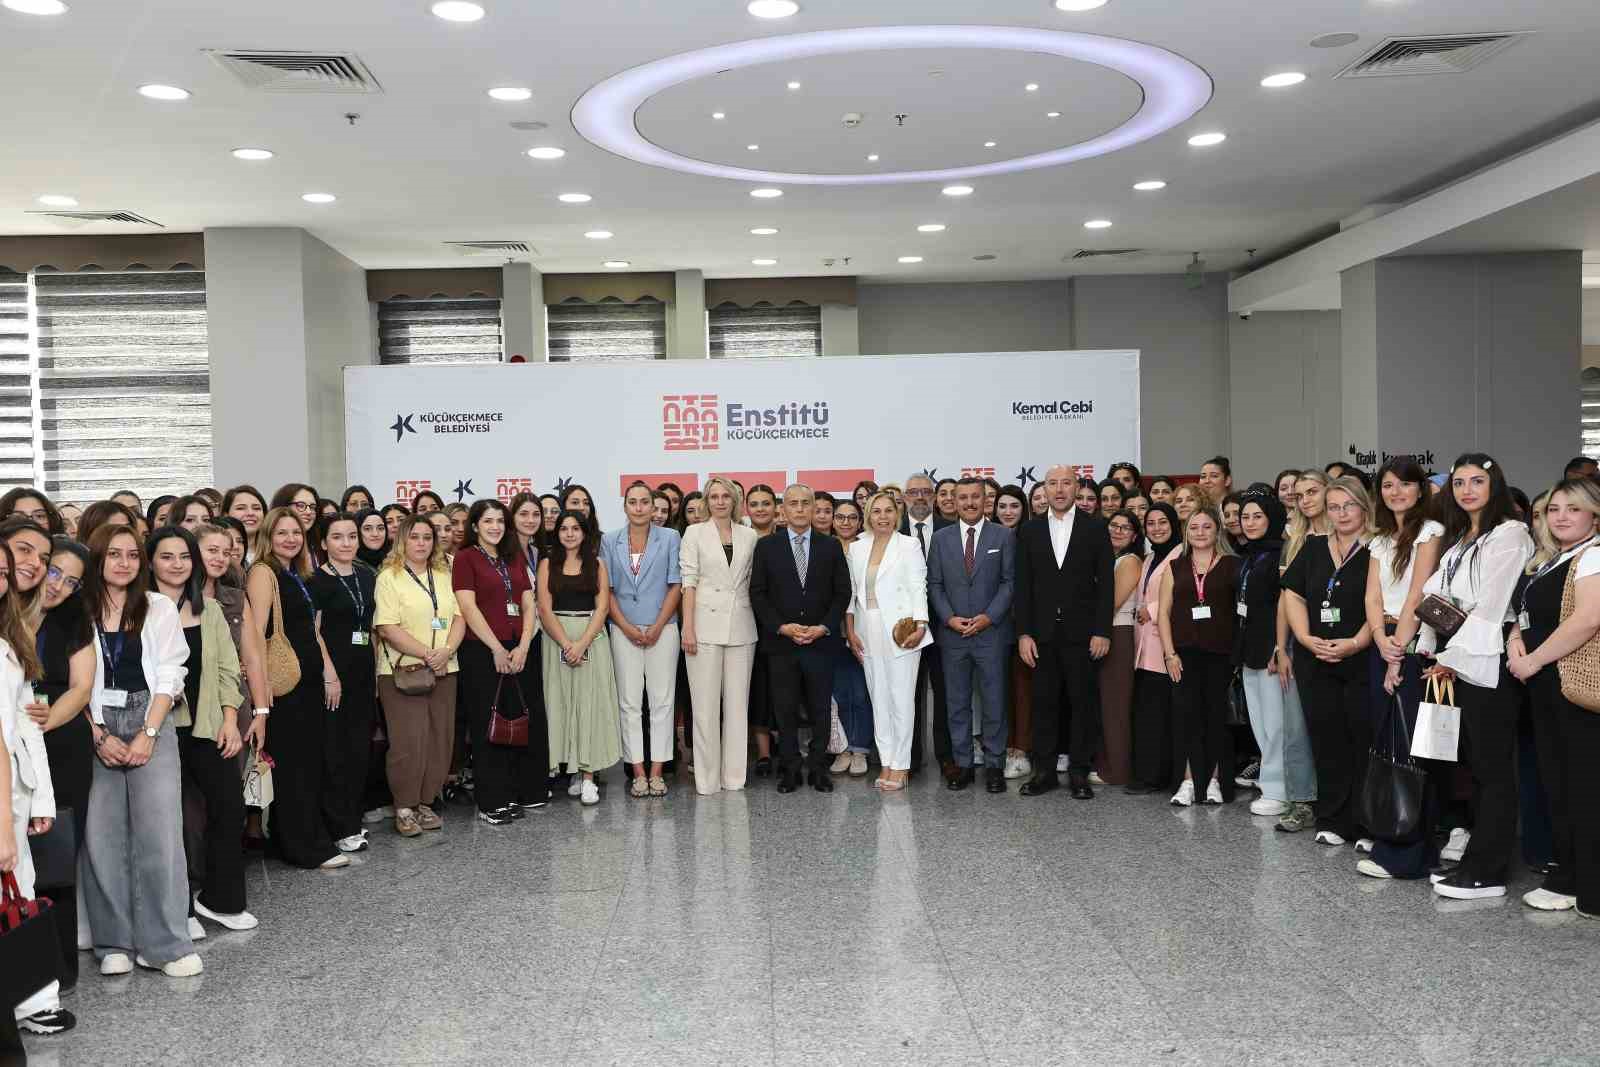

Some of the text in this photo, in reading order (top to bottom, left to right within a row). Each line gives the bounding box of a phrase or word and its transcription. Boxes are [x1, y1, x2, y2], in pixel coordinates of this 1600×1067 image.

[1012, 400, 1093, 414] Kemal Çebi
[420, 412, 503, 424] KÜÇÜKÇEKMECE
[726, 402, 829, 427] Enstitü
[434, 423, 490, 433] BELEDİYESİ
[727, 428, 829, 440] KÜÇÜKÇEKMECE
